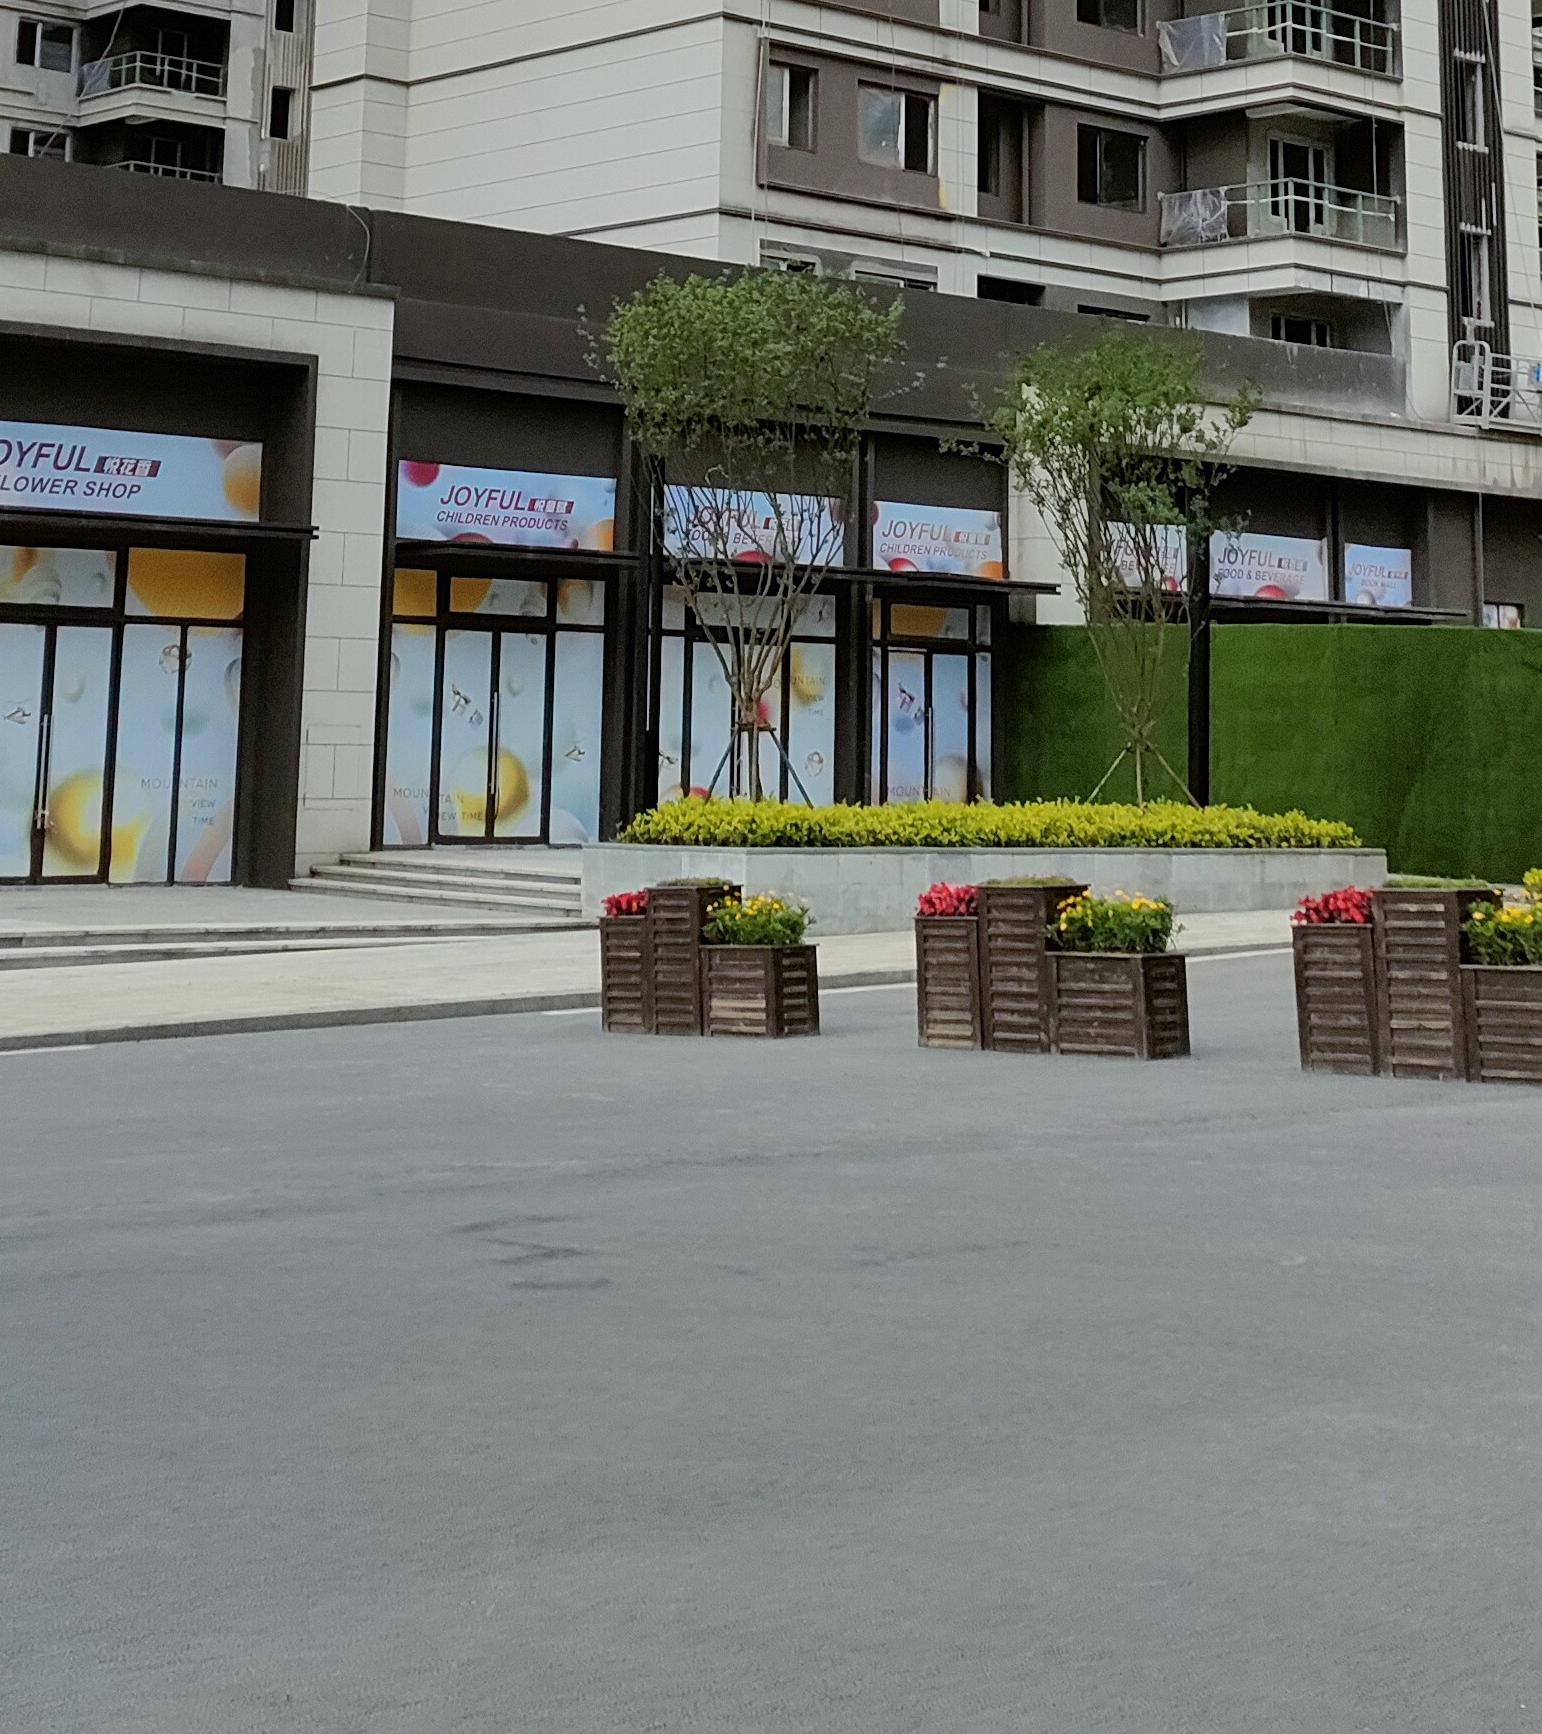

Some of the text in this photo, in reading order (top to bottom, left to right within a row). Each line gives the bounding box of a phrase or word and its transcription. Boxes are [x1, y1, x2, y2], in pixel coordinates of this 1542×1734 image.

[83, 480, 143, 501] SHOP
[440, 485, 526, 511] JOYFUL
[436, 510, 569, 532] CHILDREN PRODUCTS
[881, 519, 953, 543] JOYFUL
[879, 542, 988, 561] CHILDREN PRODUCTS
[1217, 546, 1277, 568] JOYFUL
[1217, 567, 1306, 586] FOOD & BEVERAGE
[1347, 562, 1387, 579] JOYFUL
[140, 776, 219, 790] MOUNTAIN
[192, 815, 215, 826] TIME
[422, 805, 484, 822] VEW TIME
